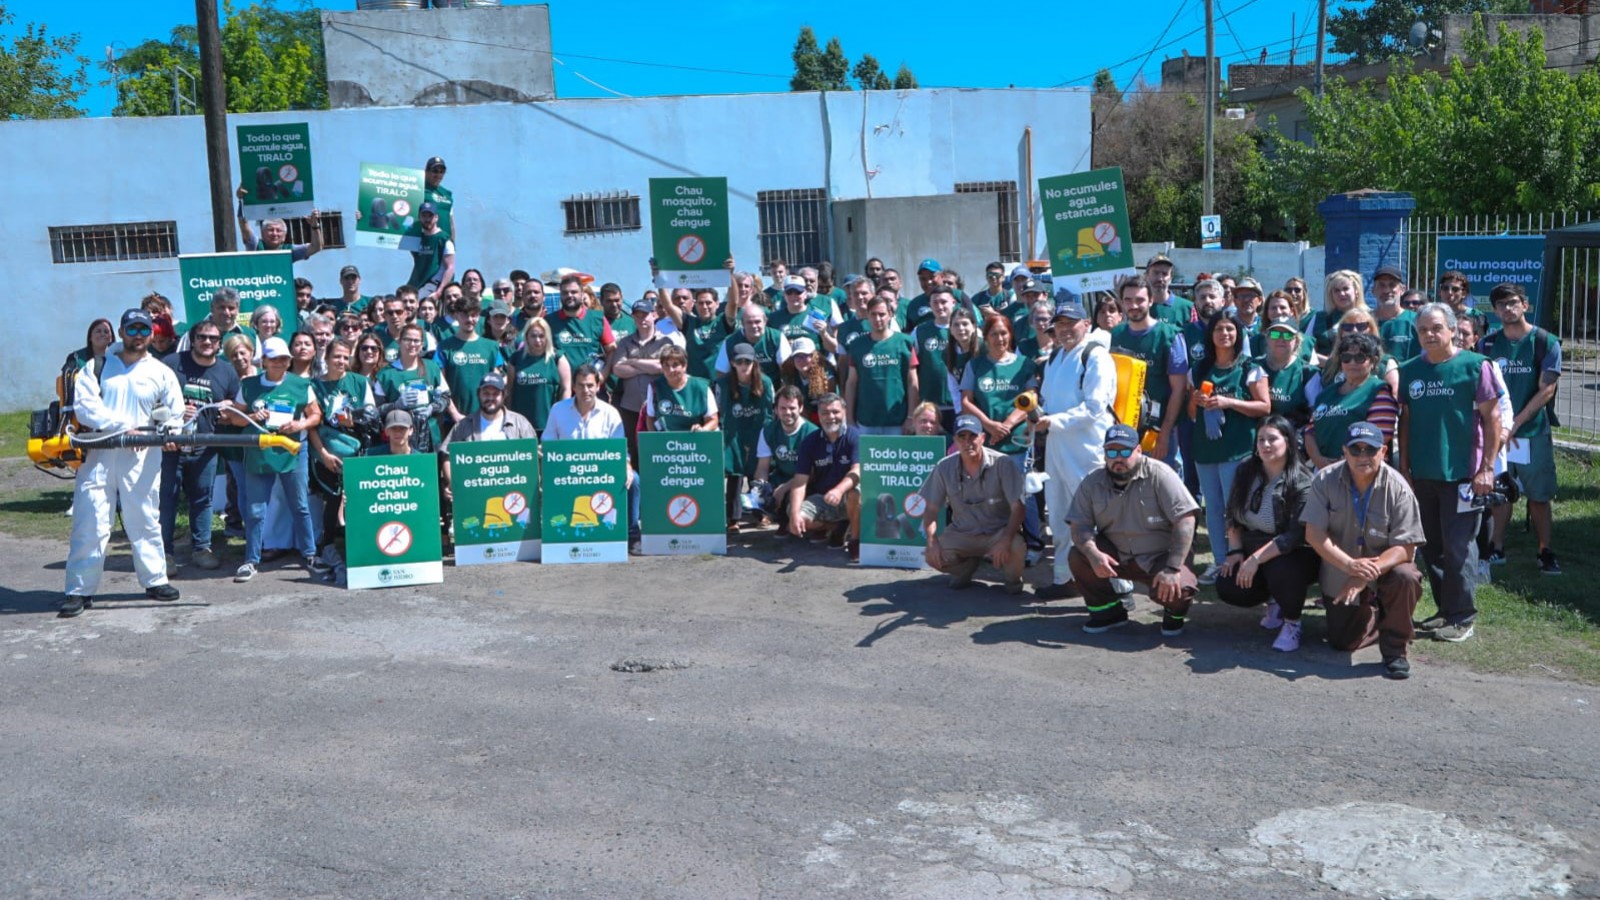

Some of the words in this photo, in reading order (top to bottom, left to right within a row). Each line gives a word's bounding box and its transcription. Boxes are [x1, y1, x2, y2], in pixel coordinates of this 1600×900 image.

[246, 134, 271, 142] Todo
[272, 133, 281, 141] lo
[282, 133, 301, 142] que
[242, 144, 280, 152] acumule
[282, 143, 307, 151] agua,
[257, 153, 293, 162] TIRALO
[368, 169, 389, 178] Todo
[362, 177, 398, 187] acumule
[376, 186, 408, 197] TIRALO
[675, 186, 703, 195] Chau
[1045, 189, 1062, 199] No
[1063, 181, 1118, 196] acumules
[662, 197, 717, 207] mosquito,
[1069, 196, 1097, 208] agua
[677, 207, 703, 216] chau
[1055, 204, 1115, 220] estancada
[670, 218, 711, 229] dengue
[1445, 259, 1478, 269] Chau
[189, 277, 223, 288] Chau
[224, 274, 287, 287] mosquito,
[1483, 272, 1537, 283] dengue.
[238, 288, 281, 300] engue.
[1427, 380, 1444, 388] SAN
[1426, 387, 1455, 396] ISIDRO
[666, 440, 696, 451] Chau
[455, 454, 473, 465] No
[475, 451, 533, 464] acumules
[547, 452, 564, 462] No
[565, 450, 621, 462] acumules
[652, 453, 711, 464] mosquito,
[869, 447, 897, 459] Todo
[898, 448, 910, 459] lo
[911, 450, 934, 461] que
[375, 465, 409, 476] Chau
[480, 465, 510, 476] agua
[569, 463, 598, 475] agua
[668, 464, 696, 474] chau
[863, 462, 908, 472] acumule
[359, 477, 425, 490] mosquito,
[464, 475, 527, 487] estancada
[553, 473, 615, 485] estancada
[660, 476, 705, 488] dengue
[880, 475, 923, 487] TIRALO
[377, 489, 409, 500] chau
[369, 502, 418, 515] dengue
